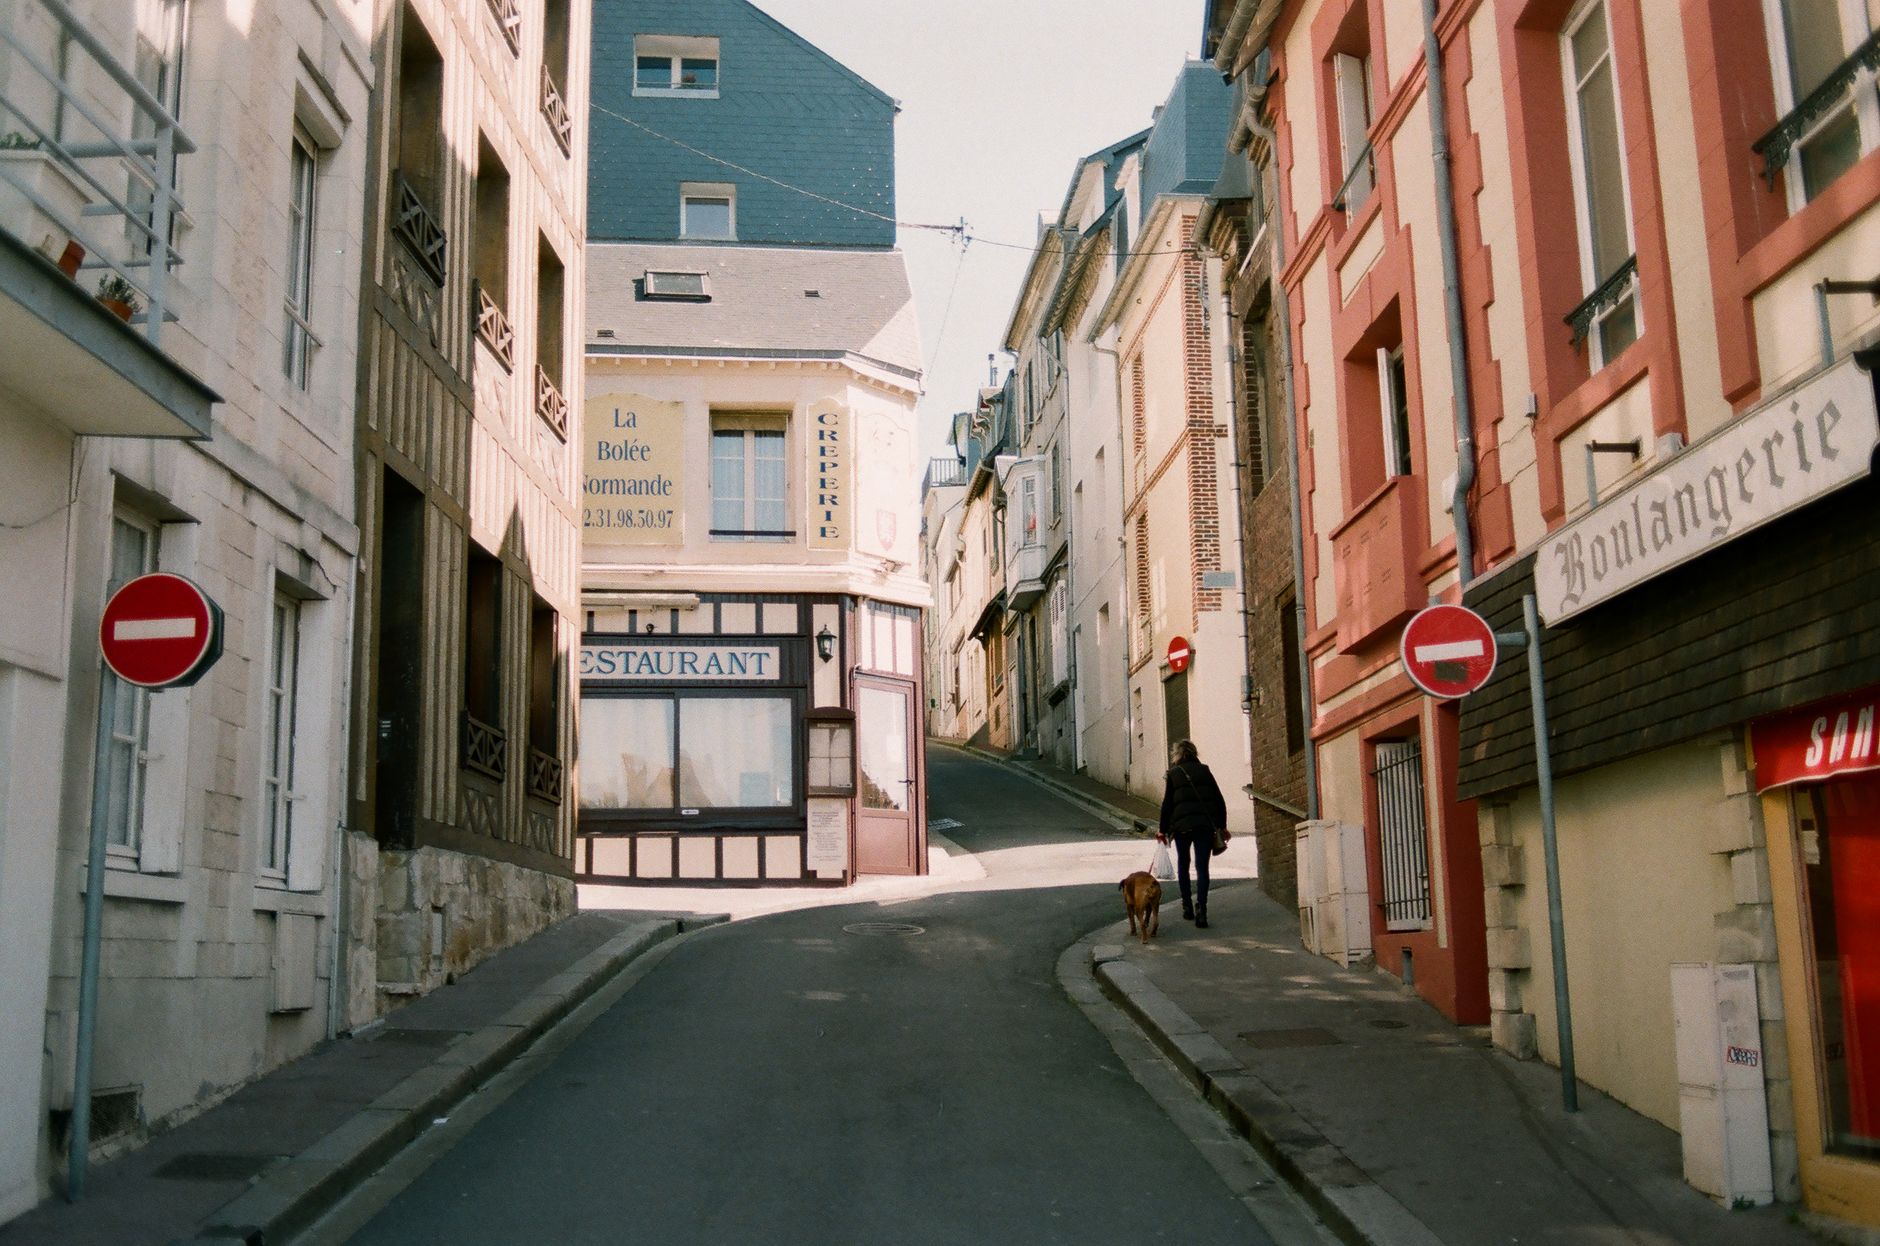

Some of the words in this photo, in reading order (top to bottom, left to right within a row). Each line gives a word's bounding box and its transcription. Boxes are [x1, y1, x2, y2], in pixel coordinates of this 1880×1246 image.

[597, 438, 651, 462] Bolée
[614, 407, 637, 428] La
[817, 412, 840, 539] CREPERIE
[1553, 398, 1843, 613] Boulangerie
[1804, 703, 1880, 769] SAN
